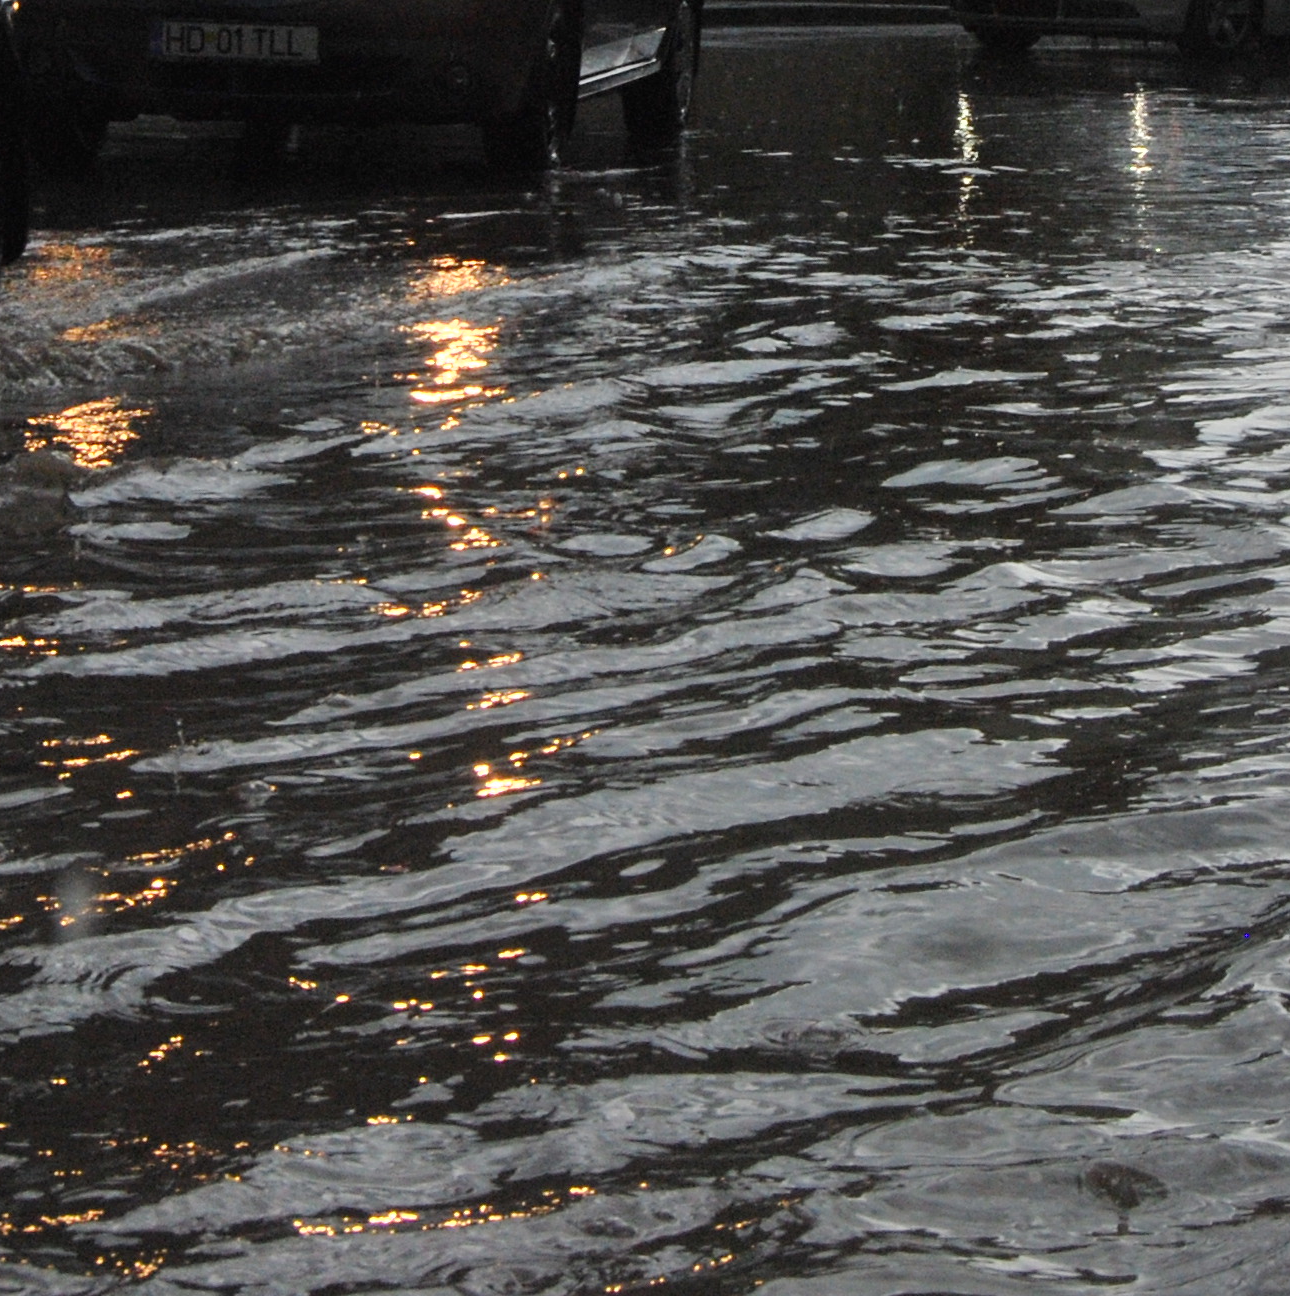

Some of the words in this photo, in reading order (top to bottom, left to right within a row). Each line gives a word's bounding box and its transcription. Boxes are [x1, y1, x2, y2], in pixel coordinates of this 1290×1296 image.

[165, 24, 205, 54] HD
[217, 27, 243, 55] 01
[253, 28, 303, 56] TLL
